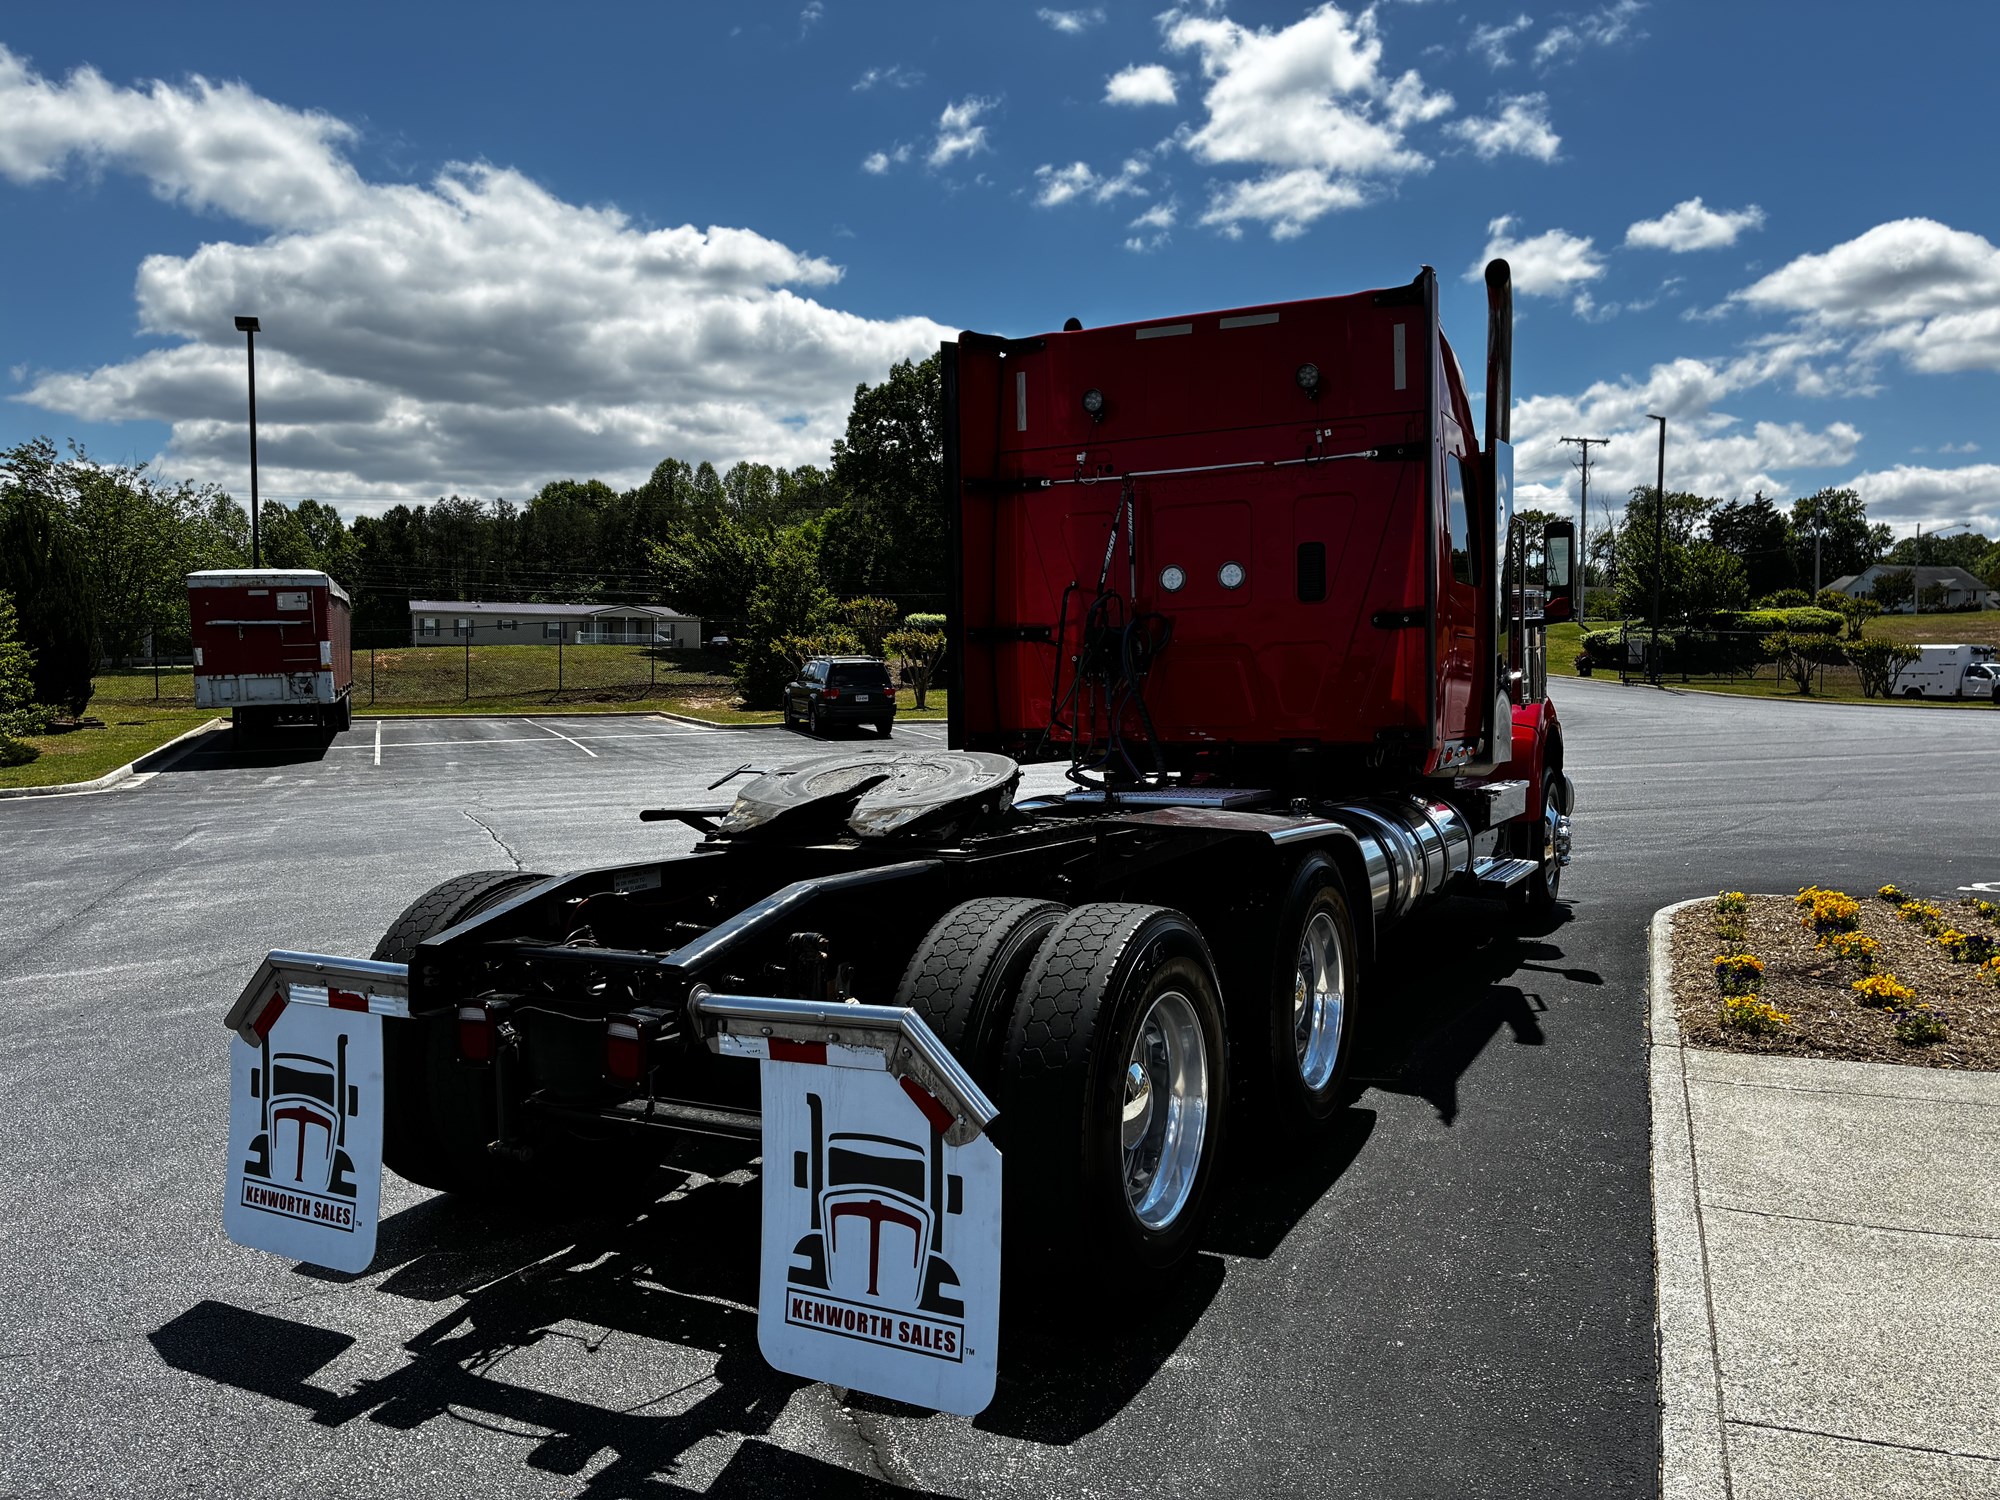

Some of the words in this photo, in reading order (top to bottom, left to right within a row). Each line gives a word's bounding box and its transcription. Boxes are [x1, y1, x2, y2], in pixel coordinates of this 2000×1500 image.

[246, 1185, 311, 1216] KENWORTH
[314, 1201, 351, 1225] SALES
[792, 1298, 892, 1339] KENWORTH
[899, 1321, 956, 1353] SALES
